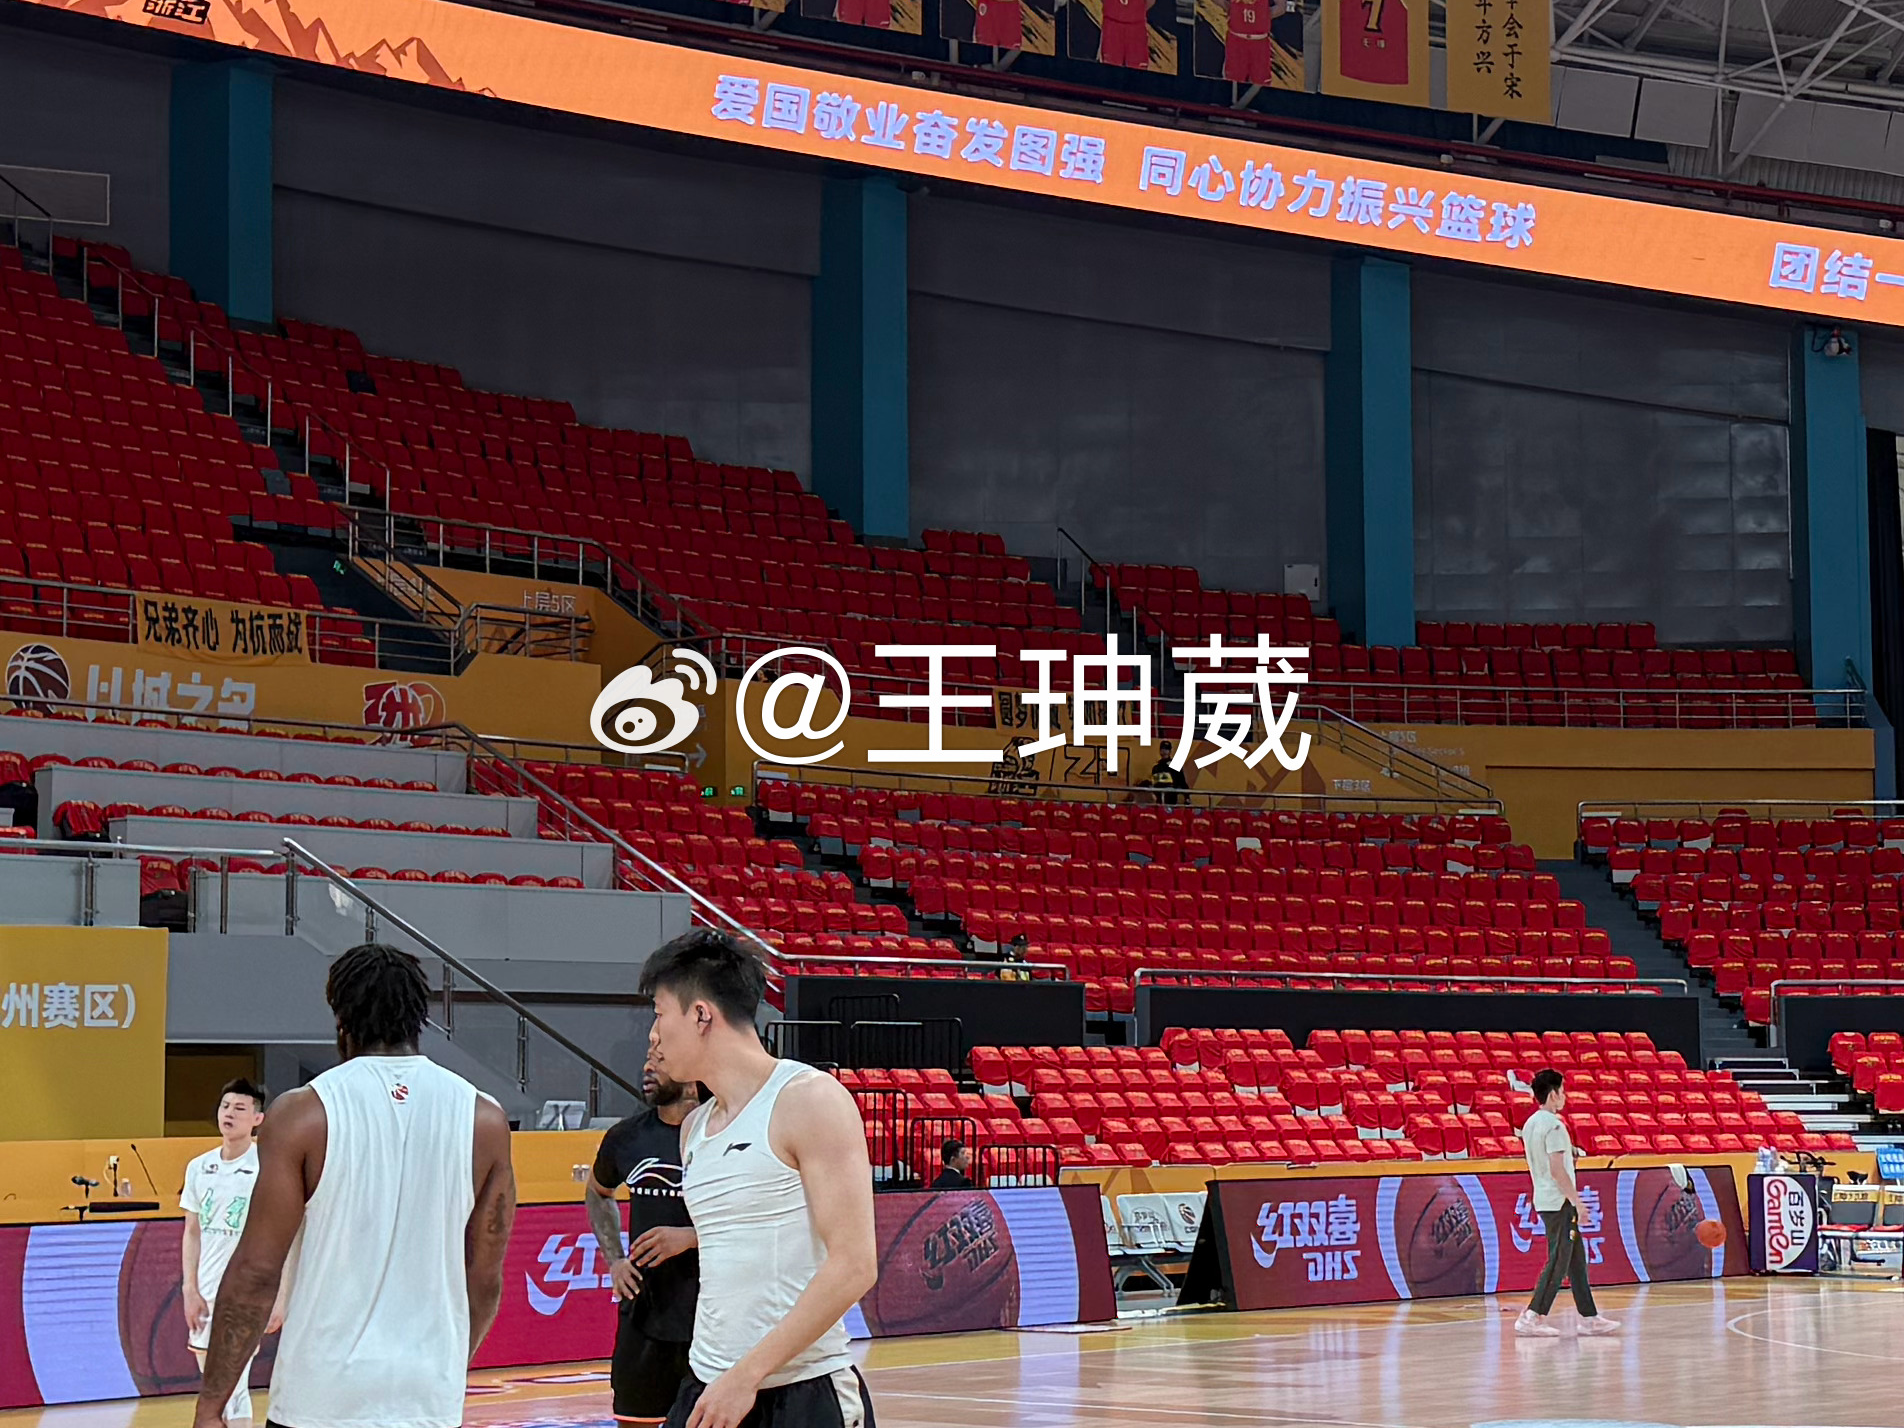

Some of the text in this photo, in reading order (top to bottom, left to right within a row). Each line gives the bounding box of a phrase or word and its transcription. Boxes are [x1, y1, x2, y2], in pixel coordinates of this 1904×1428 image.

[712, 74, 1536, 251] 爱国敬业奋发图强 同心协力振兴篮球
[142, 601, 220, 652] 兄弟齐心
[1252, 1193, 1361, 1252] 红双喜
[1788, 1190, 1805, 1246] 百岁山
